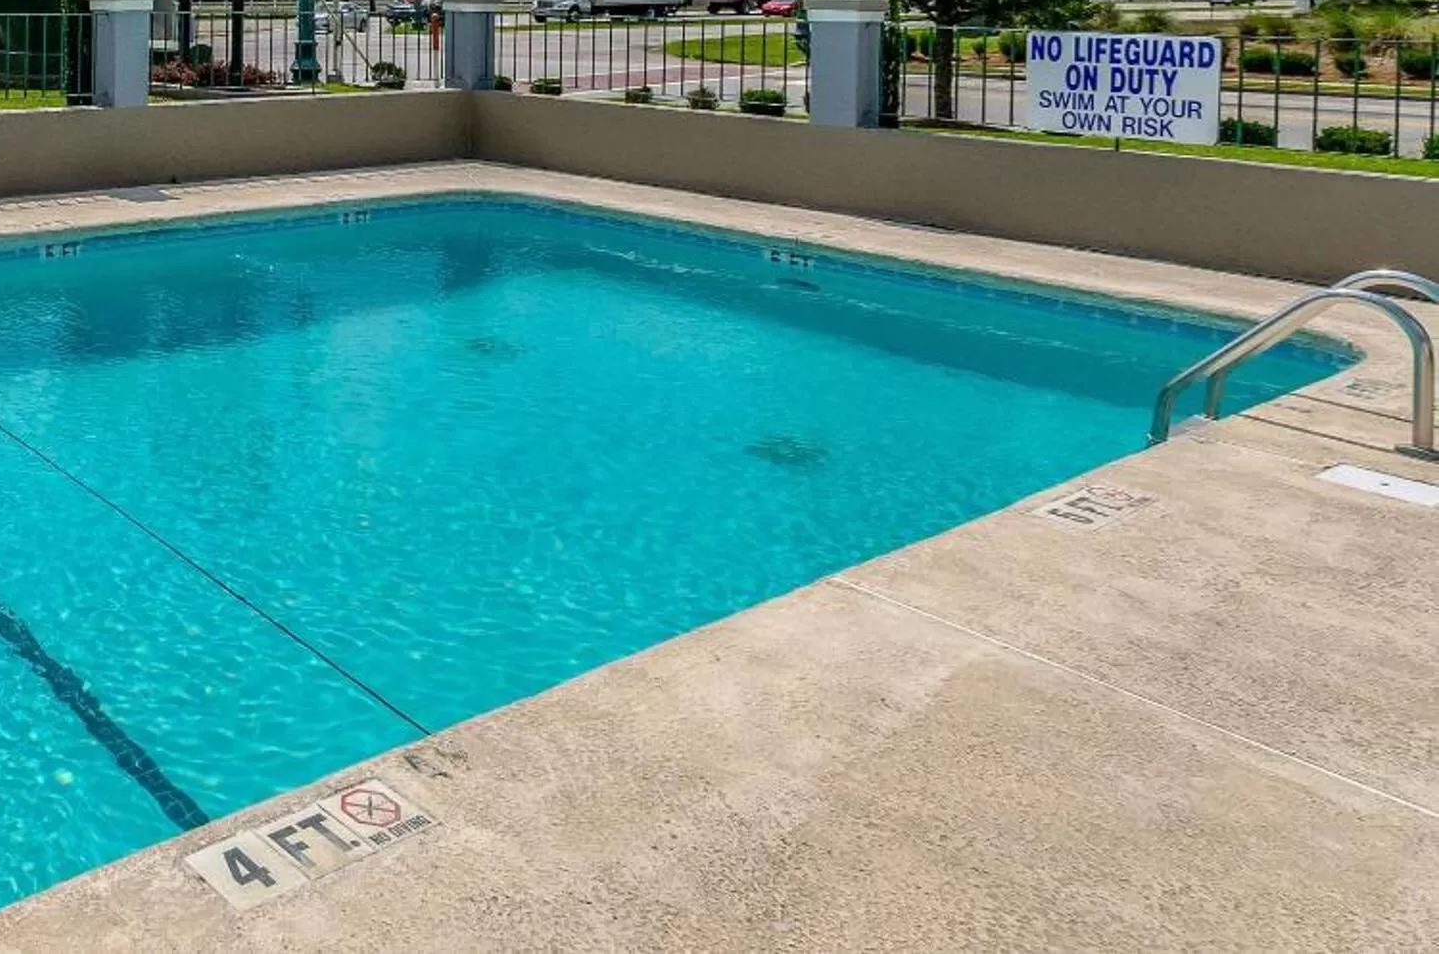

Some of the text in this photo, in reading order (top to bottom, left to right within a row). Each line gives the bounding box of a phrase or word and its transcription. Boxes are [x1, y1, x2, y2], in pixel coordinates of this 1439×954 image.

[1030, 35, 1216, 69] NO LIFEGUARD
[1065, 64, 1178, 97] ON DUTY
[1039, 89, 1202, 120] SWIM AT YOUR
[1061, 110, 1175, 139] OWN RISK
[368, 831, 392, 846] NO
[221, 846, 277, 888] 4
